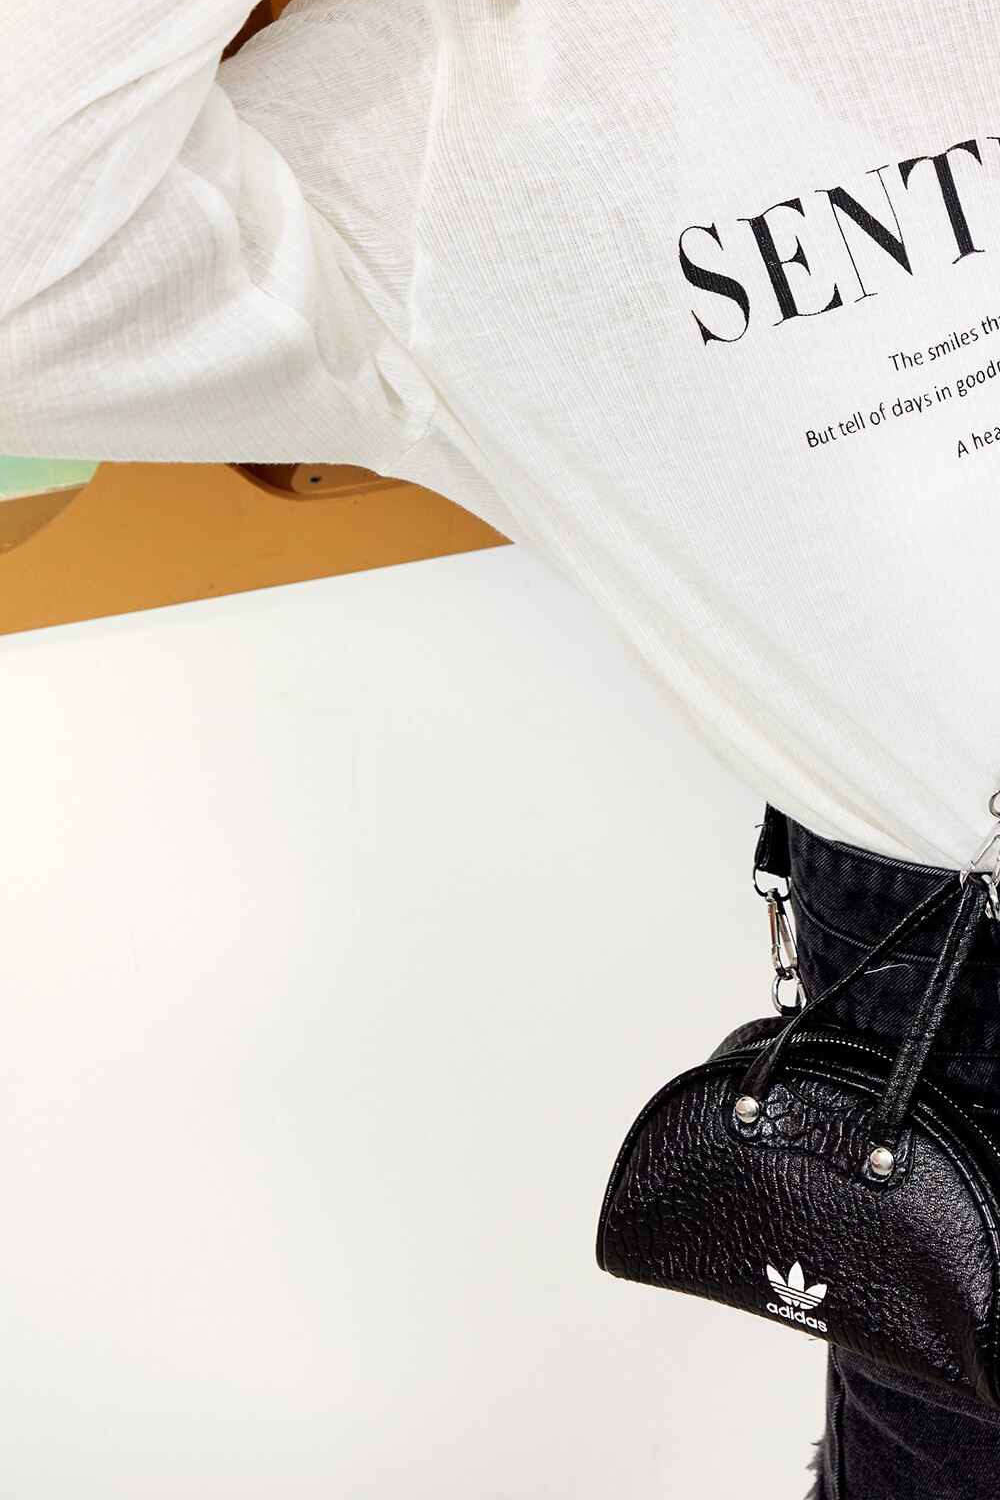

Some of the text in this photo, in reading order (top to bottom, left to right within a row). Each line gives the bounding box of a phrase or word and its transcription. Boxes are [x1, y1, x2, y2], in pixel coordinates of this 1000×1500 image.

[888, 347, 924, 372] The
[927, 327, 980, 362] smiles
[805, 424, 838, 449] But
[838, 411, 866, 438] tell
[869, 401, 889, 427] of
[891, 390, 933, 418] days
[933, 384, 953, 404] in
[956, 440, 970, 459] A
[765, 1301, 829, 1333] adidas
